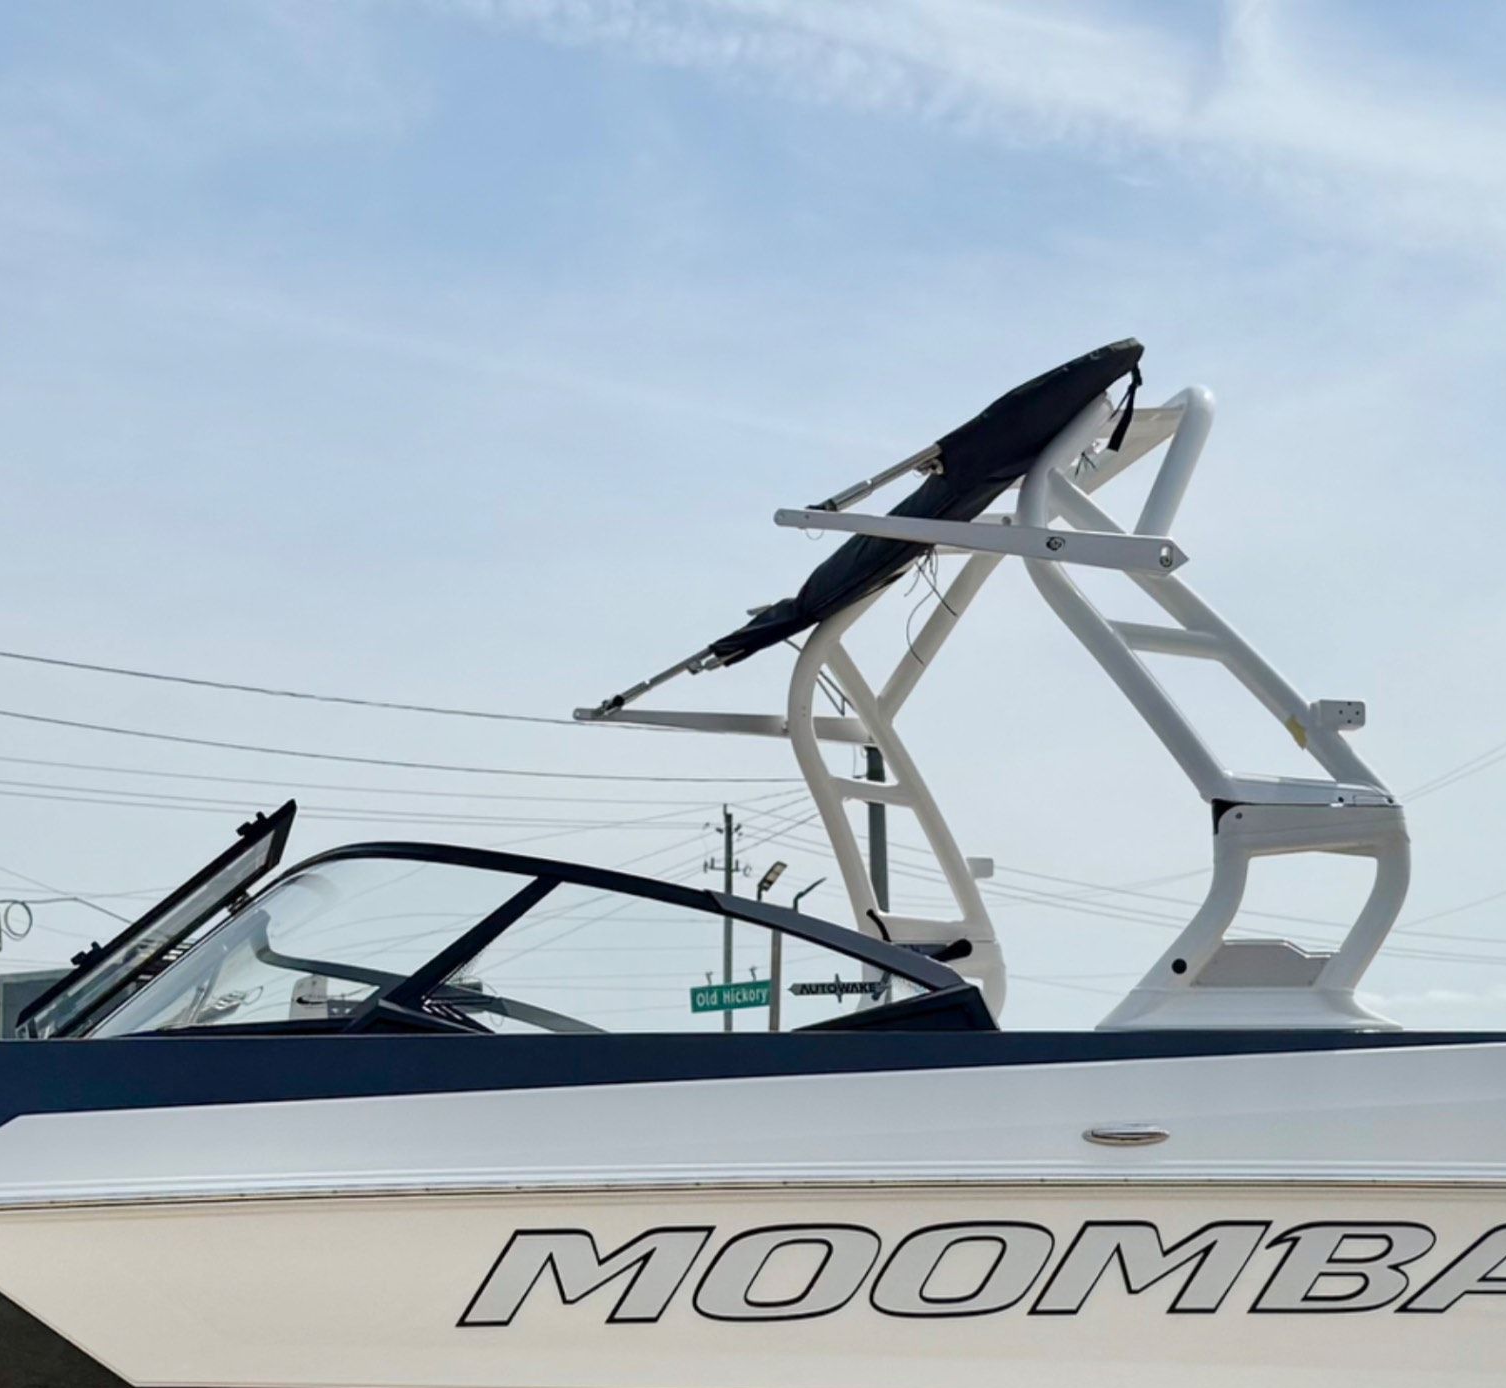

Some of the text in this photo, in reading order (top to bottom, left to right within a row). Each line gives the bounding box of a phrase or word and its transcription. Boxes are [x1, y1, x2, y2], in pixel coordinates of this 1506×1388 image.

[799, 982, 877, 994] AUTOWAKE
[696, 988, 768, 1007] Old Hickory
